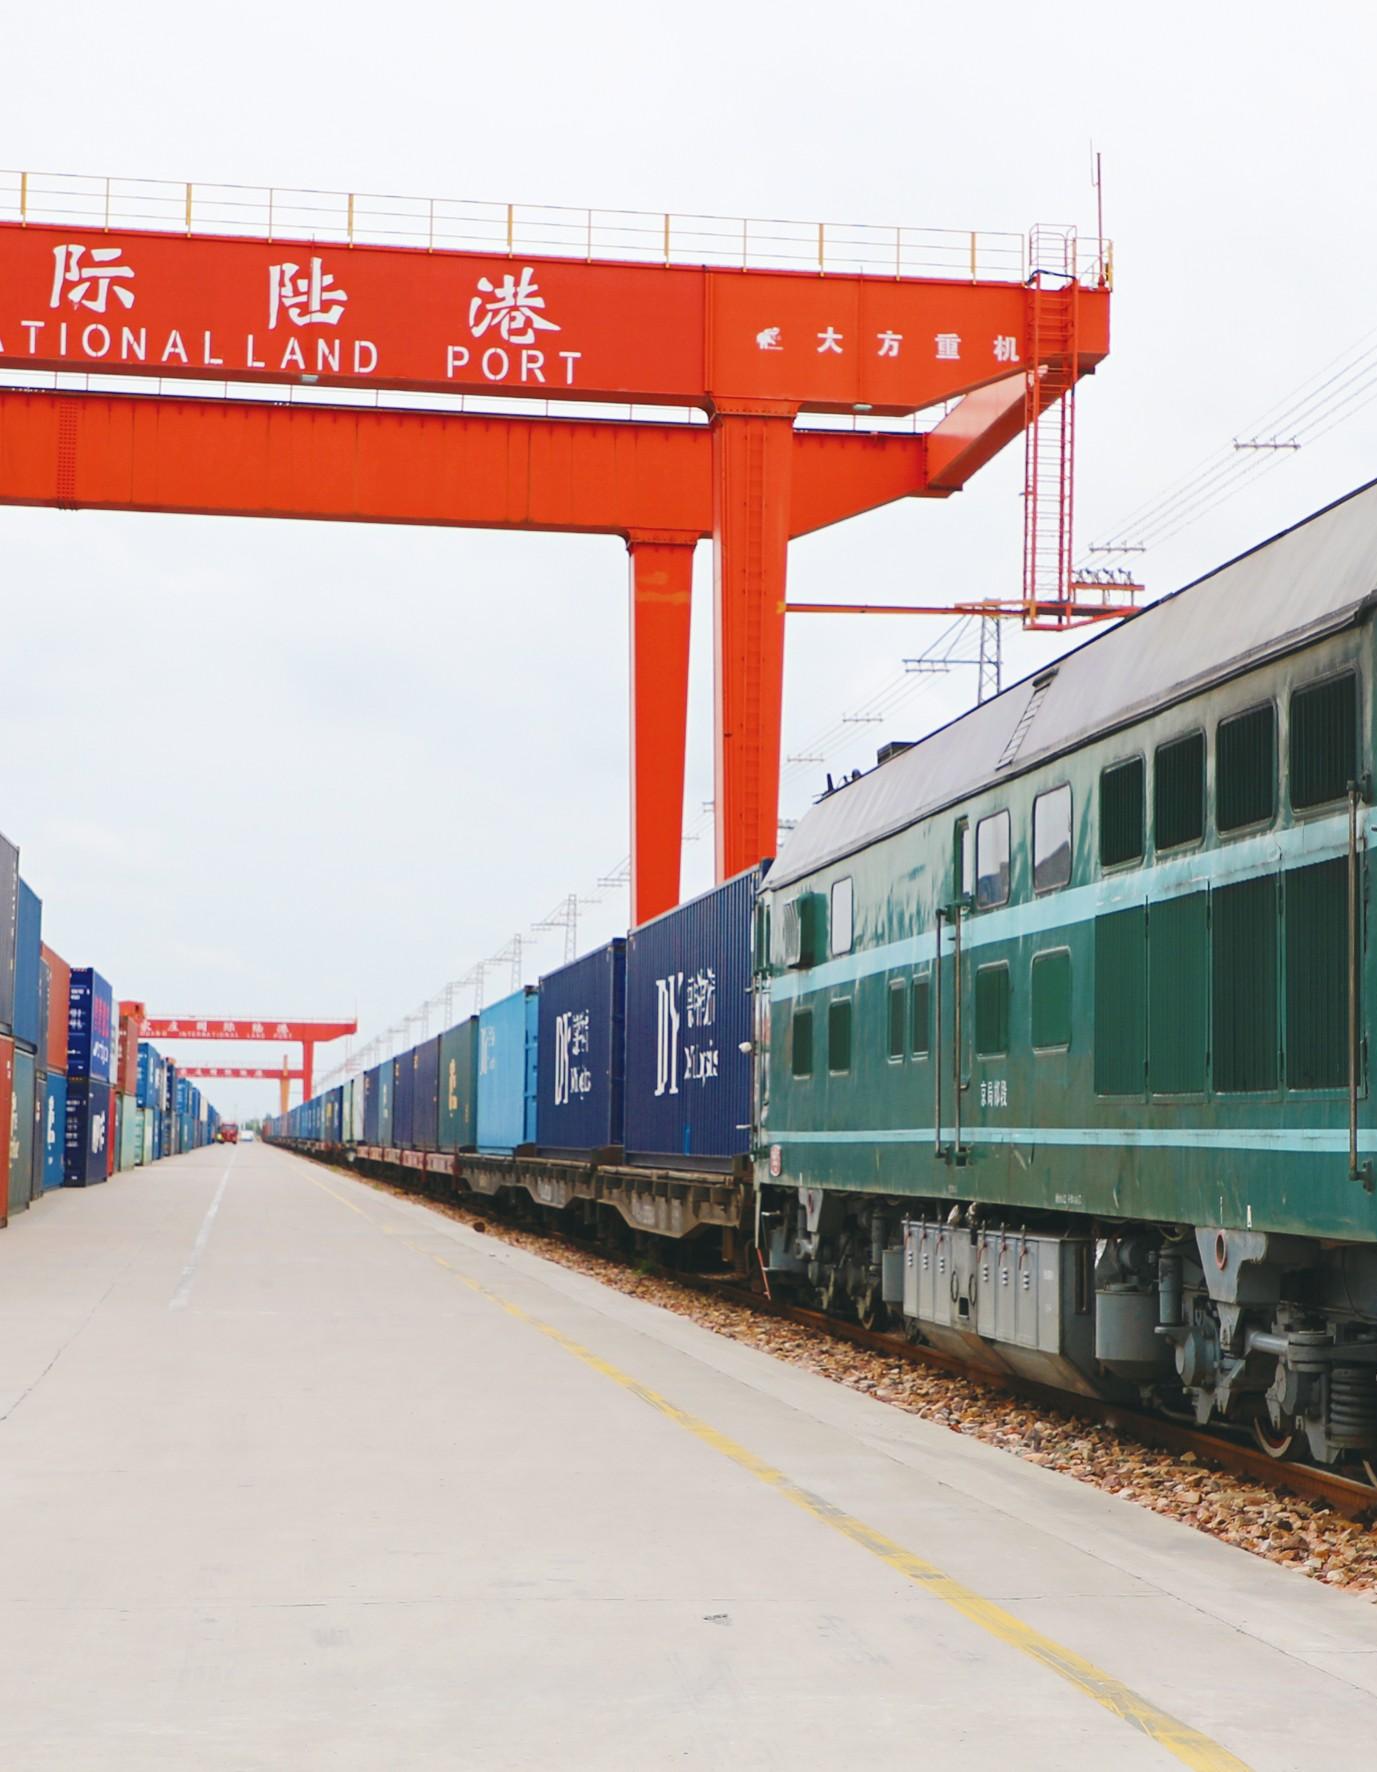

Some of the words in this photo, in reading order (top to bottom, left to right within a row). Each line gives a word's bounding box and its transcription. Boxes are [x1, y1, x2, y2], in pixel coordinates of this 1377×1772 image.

[0, 320, 224, 365] TIONAL
[247, 336, 378, 373] LAND
[446, 345, 582, 385] PORT
[817, 326, 1019, 362] 大方重机
